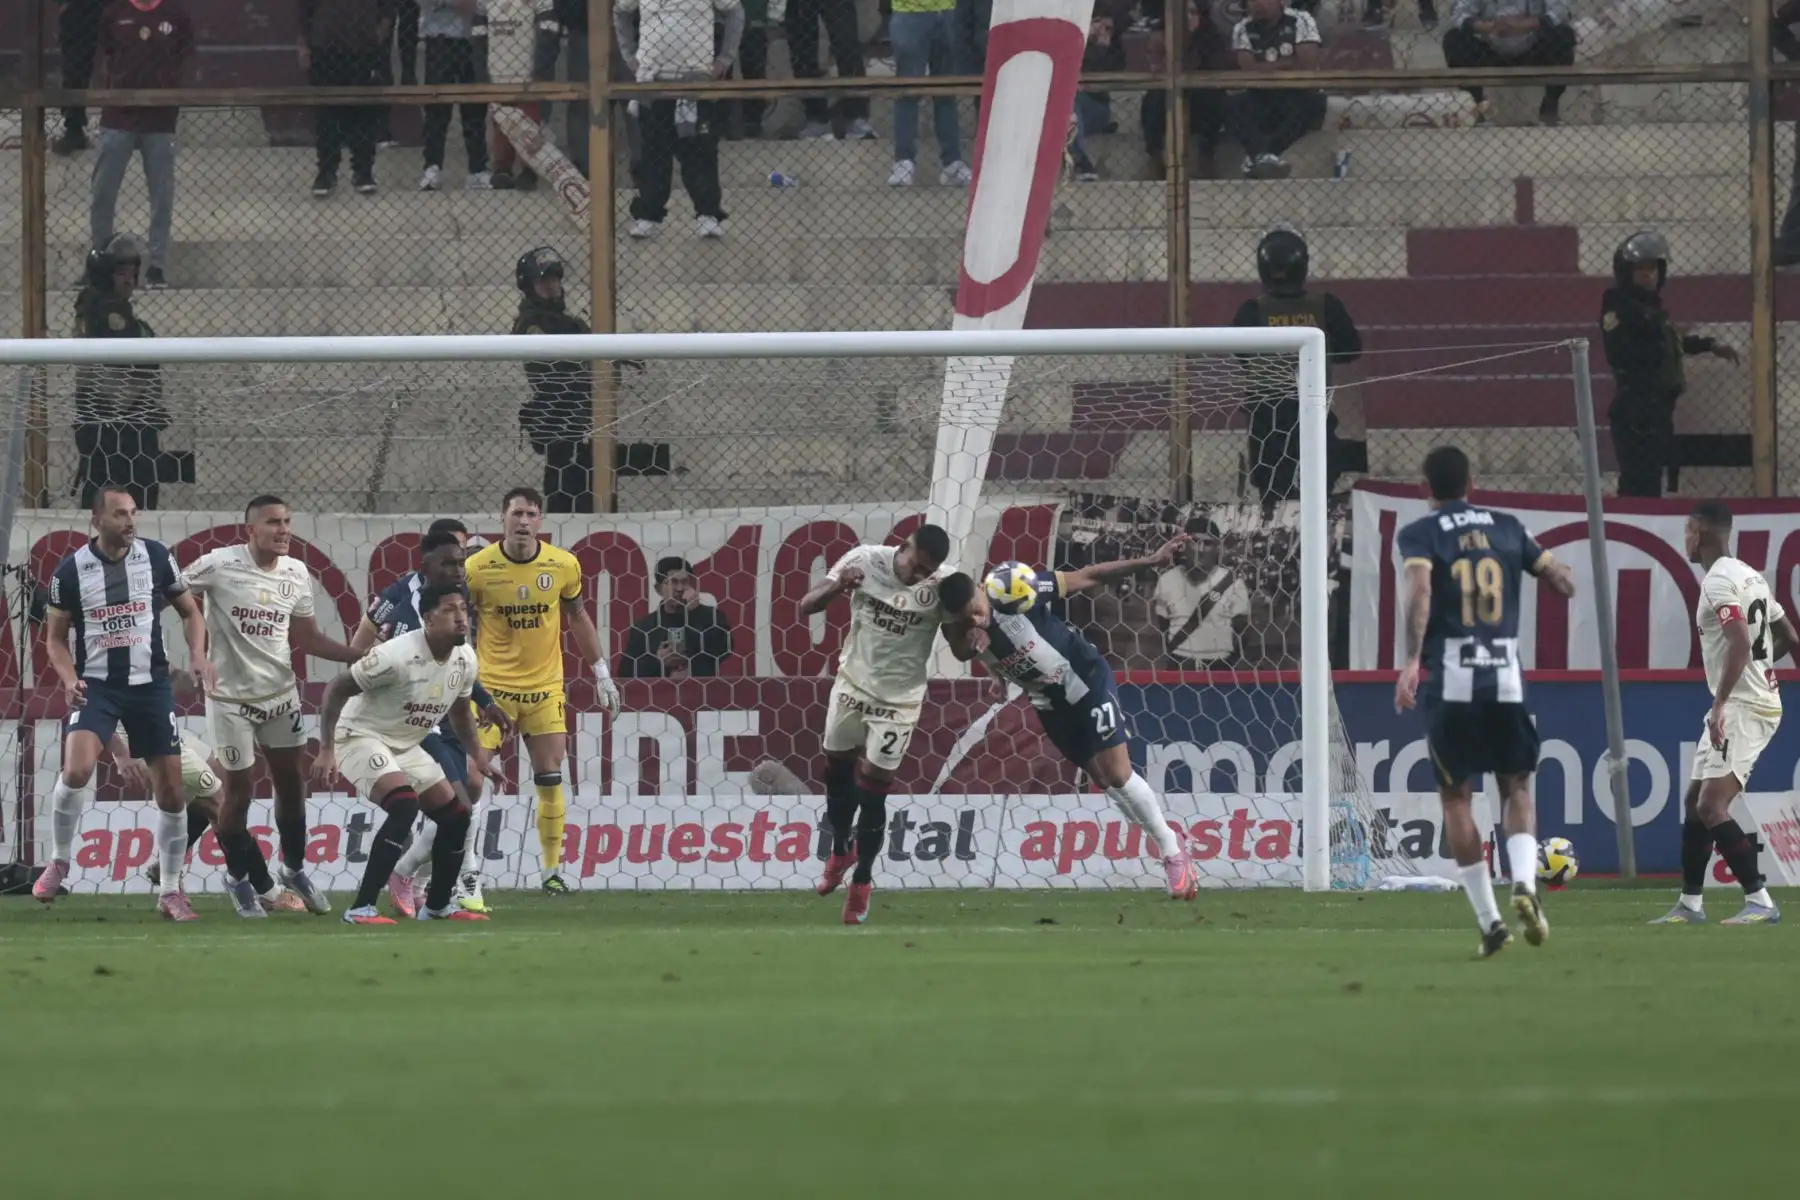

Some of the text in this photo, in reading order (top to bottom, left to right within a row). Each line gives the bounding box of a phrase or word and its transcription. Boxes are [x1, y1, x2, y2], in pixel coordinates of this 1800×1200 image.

[1268, 313, 1318, 327] POLICIA
[1451, 557, 1504, 627] 18
[90, 602, 146, 620] apuesta
[231, 606, 285, 623] apuesta
[497, 603, 549, 615] apuesta
[868, 597, 922, 625] apuesta
[101, 615, 137, 631] total
[240, 621, 274, 636] total
[507, 616, 540, 629] total
[873, 611, 908, 636] total
[492, 689, 551, 704] OPALUX
[240, 699, 293, 722] OPALUX
[838, 693, 898, 720] OPALUX
[1091, 701, 1116, 734] 27
